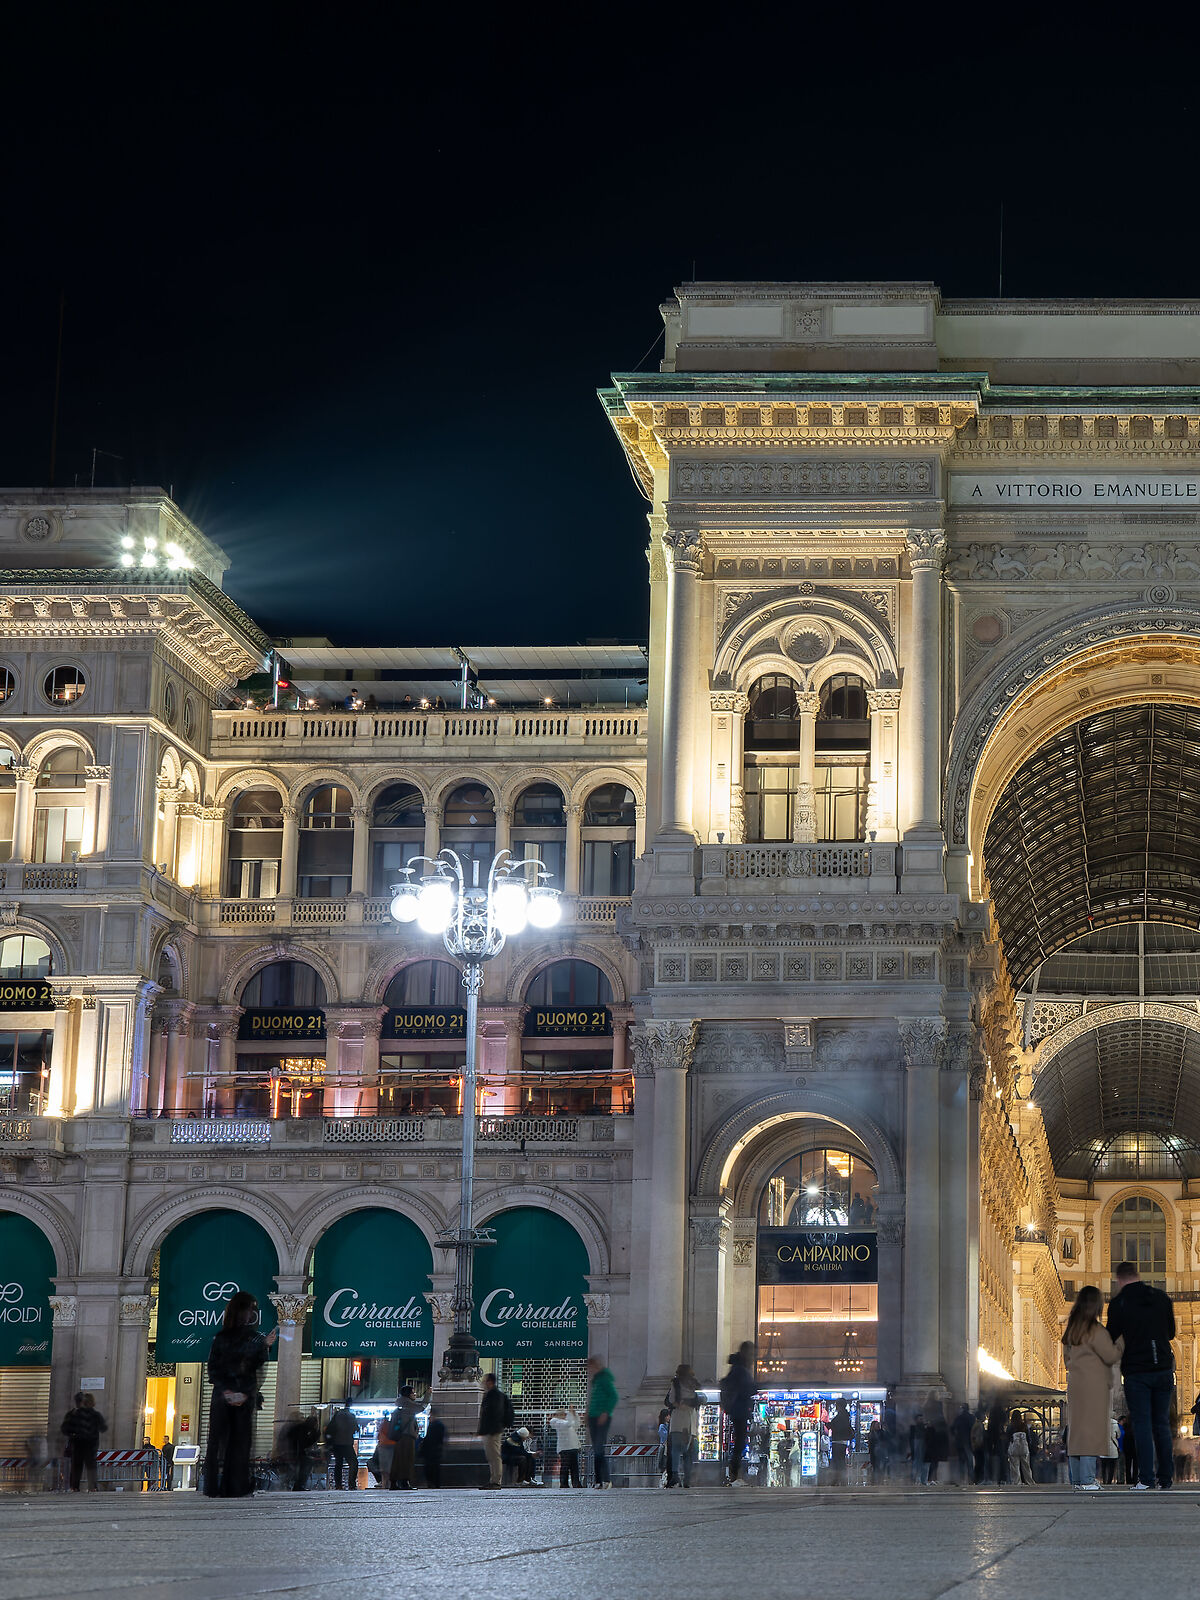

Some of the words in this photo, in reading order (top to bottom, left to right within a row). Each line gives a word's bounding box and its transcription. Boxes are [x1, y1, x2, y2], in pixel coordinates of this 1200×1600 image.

[971, 484, 983, 497] A
[996, 484, 1083, 497] VITTORIO
[1094, 483, 1198, 497] EMANUELE
[0, 986, 37, 999] OMO
[252, 1016, 304, 1029] DUOMO
[307, 1016, 322, 1029] 21
[394, 1015, 446, 1027] DUOMO
[449, 1015, 464, 1027] 21
[537, 1012, 588, 1025] DUOMO
[591, 1012, 606, 1025] 21
[777, 1244, 871, 1262] CAMPARINO
[812, 1263, 842, 1271] GALLERIA
[323, 1287, 423, 1328] Currado
[480, 1287, 579, 1328] Currado
[0, 1306, 42, 1323] OLDI
[364, 1320, 422, 1329] GIOIELLERIE
[521, 1320, 577, 1329] GIOIELLERIE
